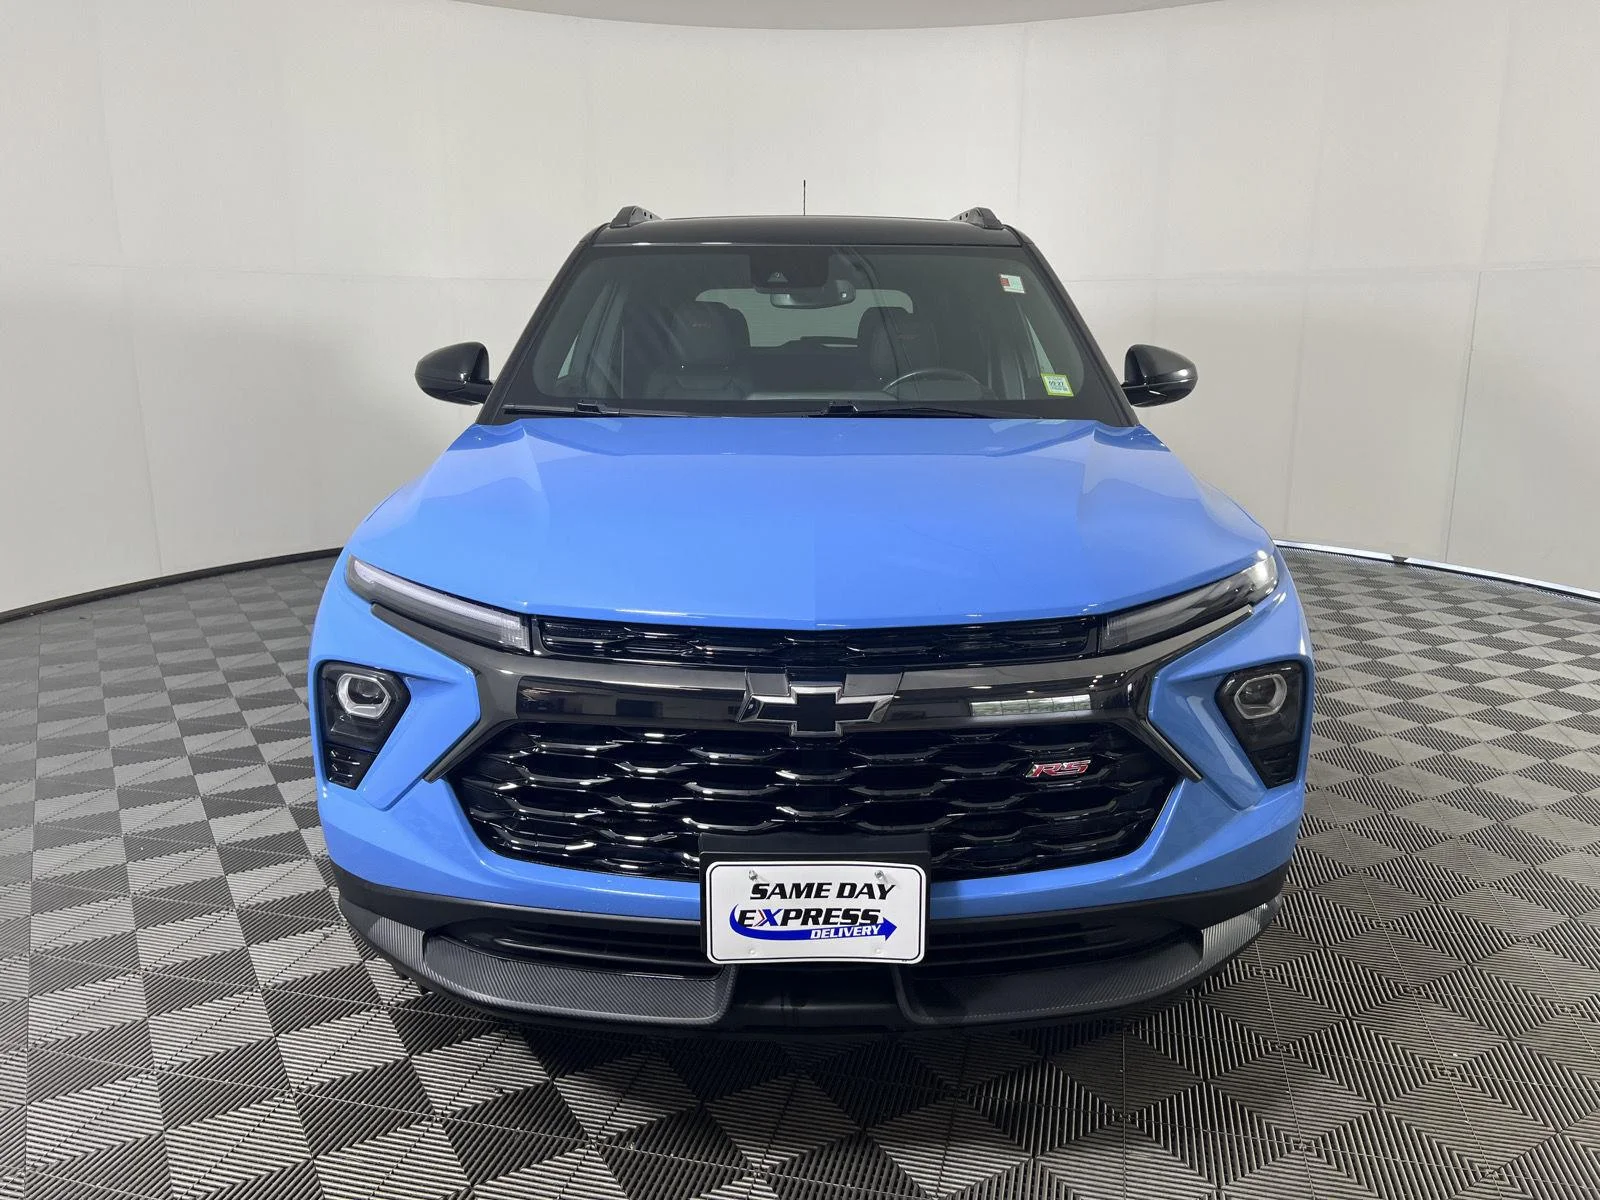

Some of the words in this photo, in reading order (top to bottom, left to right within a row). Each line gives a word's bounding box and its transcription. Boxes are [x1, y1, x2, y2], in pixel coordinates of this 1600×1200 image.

[1026, 760, 1091, 777] RS
[750, 882, 832, 900] SAME
[836, 882, 896, 900] DAY
[738, 908, 881, 927] EXPRESS
[810, 925, 882, 940] DELIVERY
